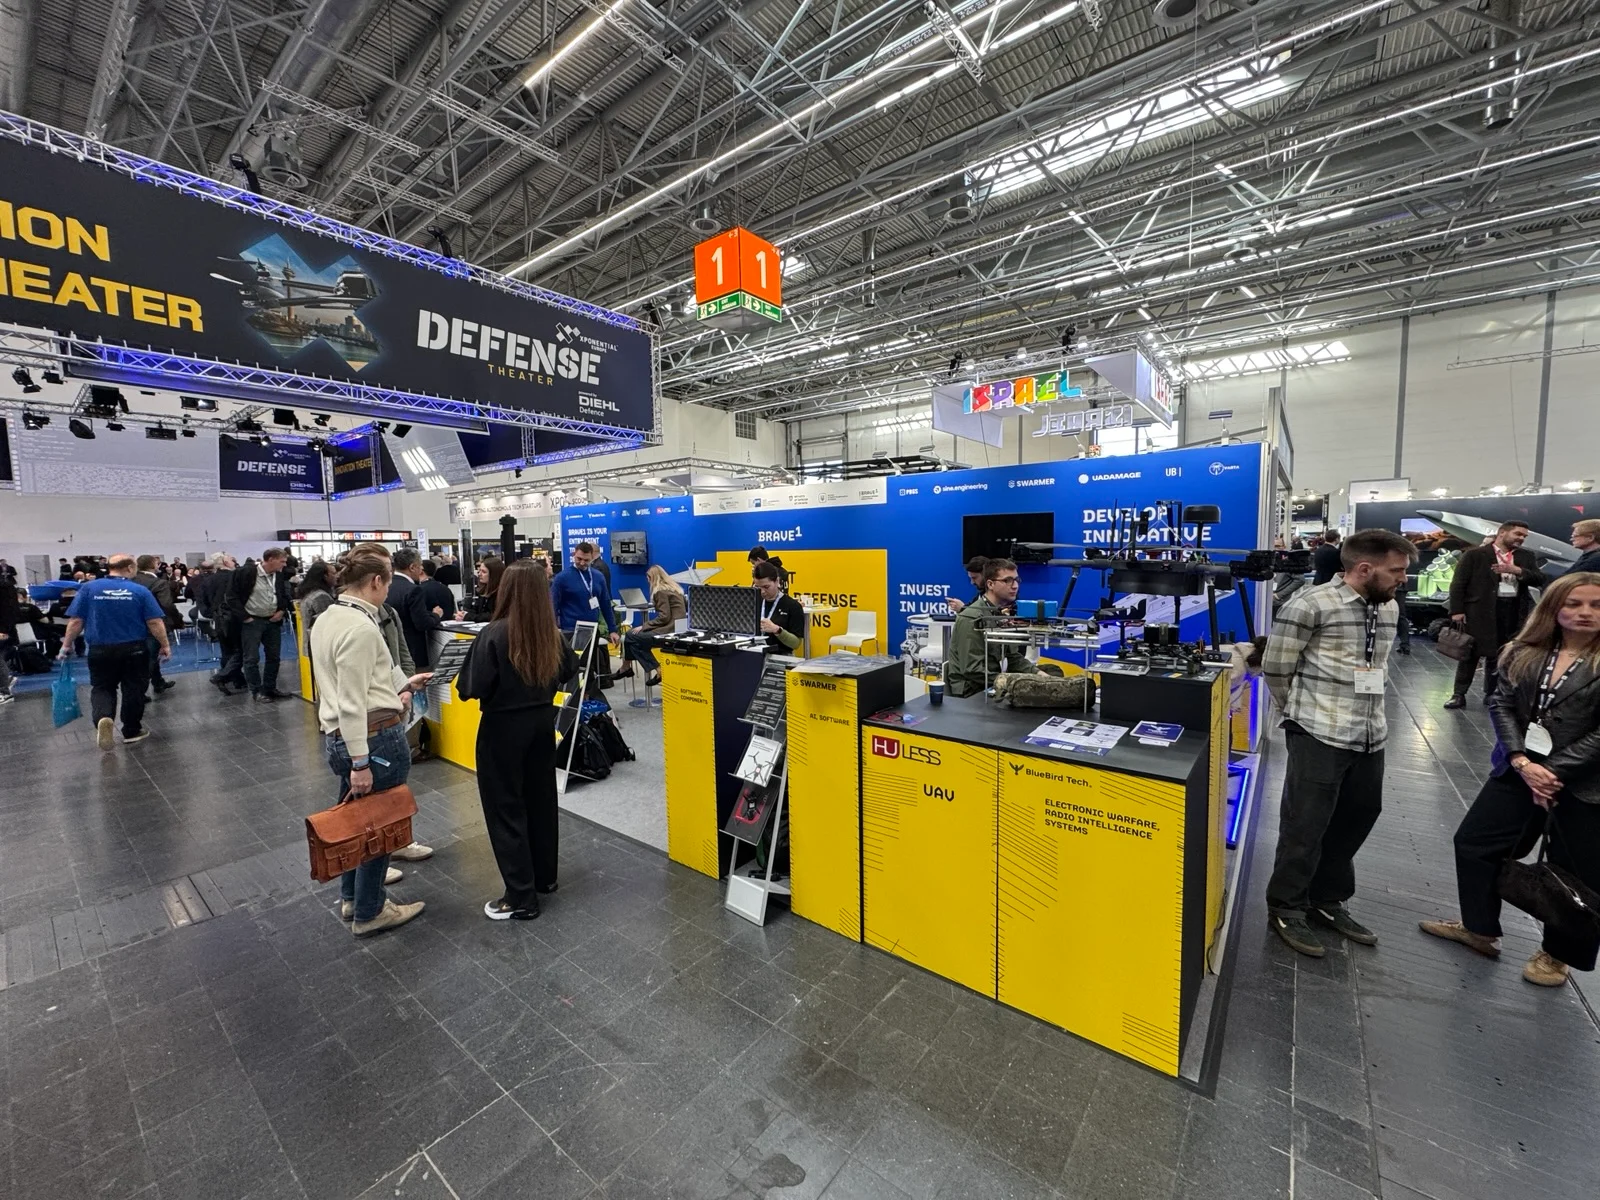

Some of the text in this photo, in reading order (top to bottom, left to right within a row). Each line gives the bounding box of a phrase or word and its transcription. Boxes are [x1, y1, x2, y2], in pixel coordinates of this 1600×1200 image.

[711, 246, 723, 286] 1
[755, 250, 767, 289] 1
[0, 257, 204, 333] EATER
[417, 309, 601, 386] DEFENSE
[580, 336, 618, 352] XPONENTIAL
[591, 344, 607, 353] EUROPE
[488, 363, 554, 387] THEATER
[962, 369, 1084, 414] ISRAEL
[578, 395, 620, 412] DIEHL
[579, 406, 605, 417] Defence
[237, 460, 307, 475] DEFENSE
[1016, 478, 1055, 487] SWARMER
[1092, 471, 1142, 481] UADAMAGE
[942, 482, 988, 492] sine.engineering
[594, 527, 607, 535] YOUR
[899, 583, 951, 597] INVEST
[899, 601, 916, 612] IN
[799, 678, 837, 692] SWARMER
[680, 694, 709, 705] COMPONENTS
[819, 714, 850, 726] SOFTWARE
[1025, 768, 1093, 788] BlueBird Tech.
[923, 783, 955, 802] UAV
[1044, 798, 1160, 832] ELECTRONIC WARFARE,
[1044, 808, 1153, 840] RADIO INTELLIGENCE
[1044, 818, 1088, 835] SYSTEMS
